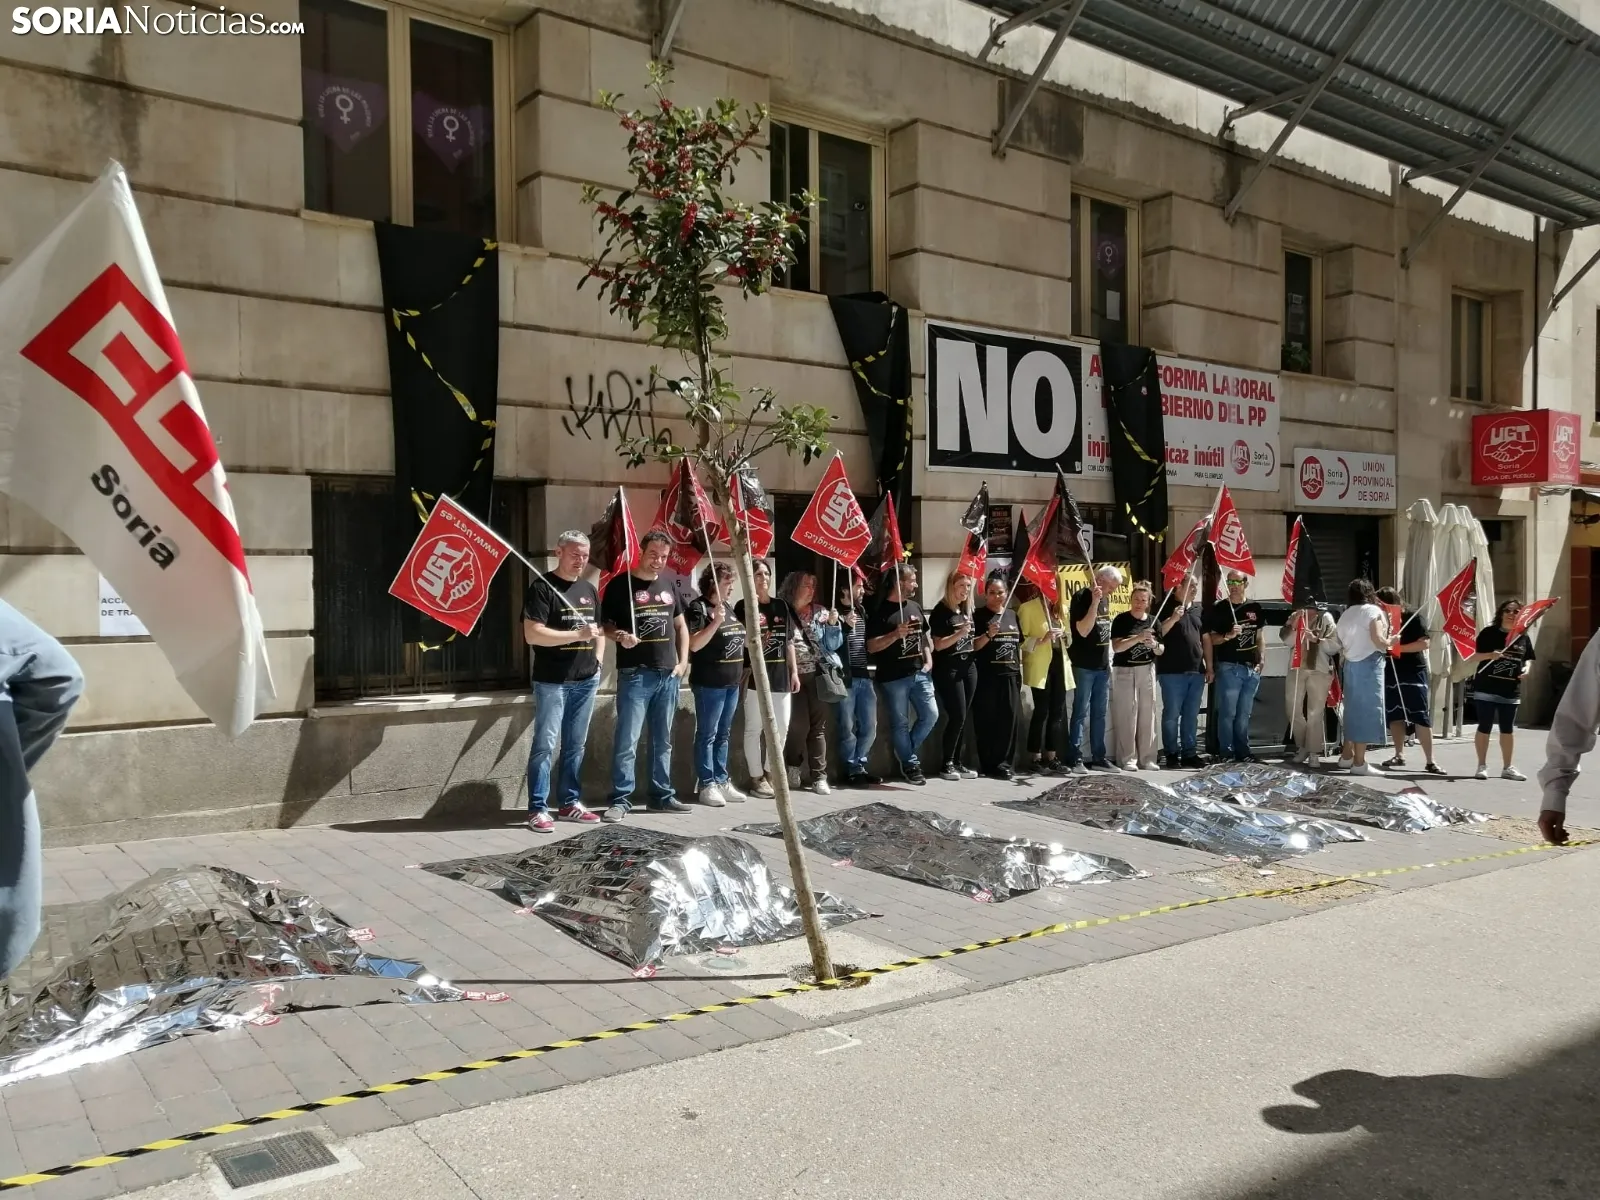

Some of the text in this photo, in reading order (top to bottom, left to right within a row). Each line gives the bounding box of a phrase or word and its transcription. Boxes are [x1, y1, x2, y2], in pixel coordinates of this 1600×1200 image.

[1156, 364, 1208, 393] FORMA
[1212, 372, 1276, 402] LABORAL
[936, 337, 1077, 459] NO
[1161, 394, 1267, 427] BIERNO DEL PP
[1490, 425, 1530, 446] UGT
[1555, 425, 1574, 443] UGT
[1087, 434, 1112, 464] inju
[1194, 442, 1225, 468] inútil
[1254, 451, 1269, 461] Soria
[1303, 463, 1321, 480] UGT
[1327, 468, 1343, 478] Soria
[1362, 460, 1385, 472] UNIÓN
[1353, 475, 1394, 487] PROVINCIAL
[820, 482, 856, 531] UGT
[1358, 491, 1390, 502] DE SORIA
[90, 463, 181, 570] Soria
[1219, 513, 1241, 555] UGT
[416, 541, 464, 598] UGT
